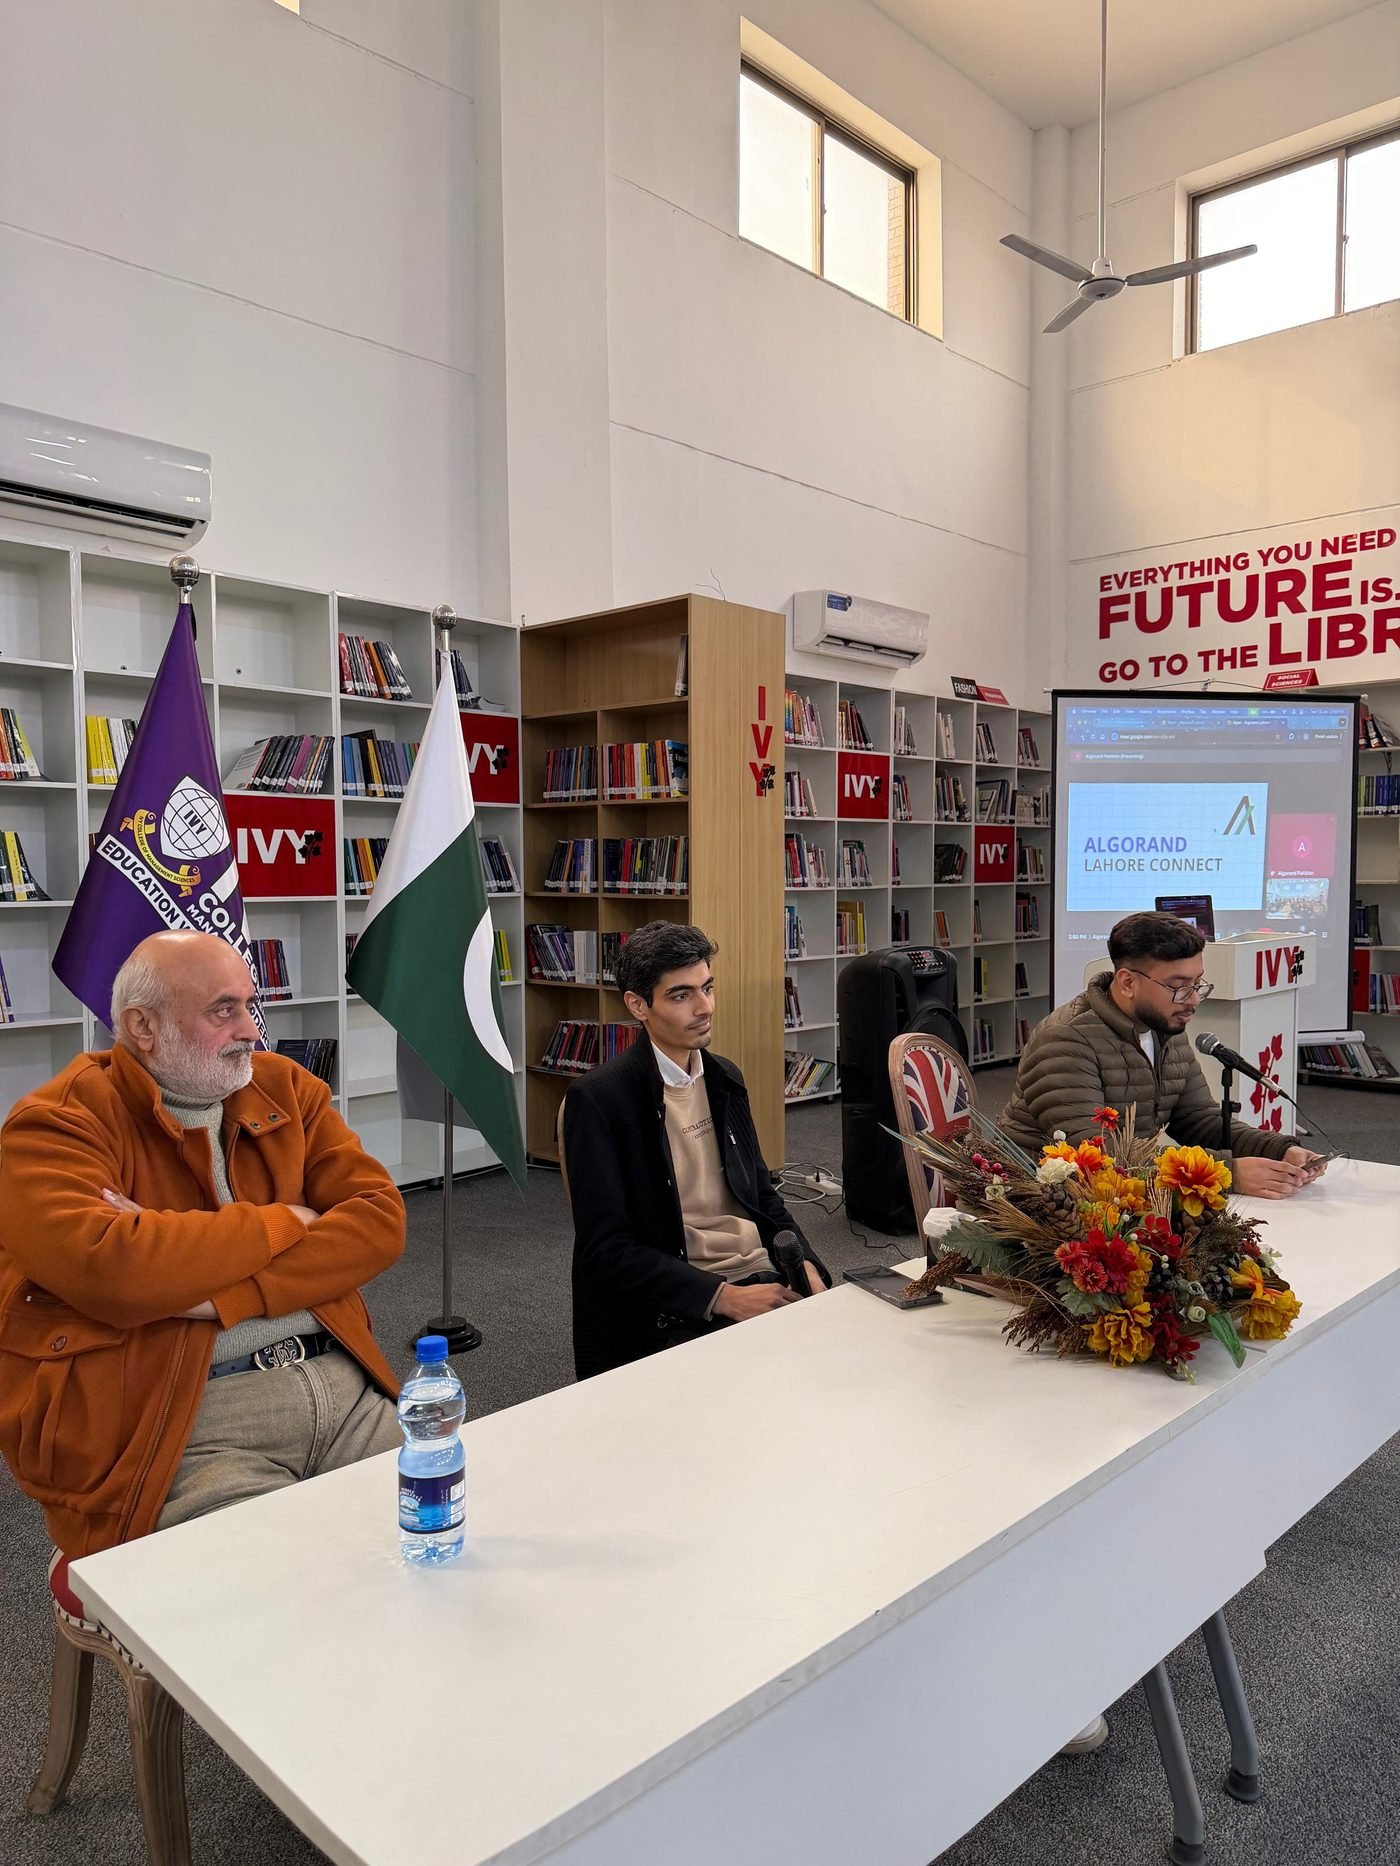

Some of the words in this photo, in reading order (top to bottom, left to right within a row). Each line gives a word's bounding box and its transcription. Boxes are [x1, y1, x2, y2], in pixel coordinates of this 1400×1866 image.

[1099, 552, 1250, 593] EVERYTHING
[1256, 541, 1313, 568] YOU
[1320, 528, 1397, 558] NEED
[1099, 559, 1353, 640] FUTURE
[1098, 659, 1140, 683] GO
[1148, 653, 1188, 678] TO
[1198, 645, 1259, 673] THE
[1268, 606, 1400, 666] LIBR
[954, 682, 978, 696] FASHION
[1277, 673, 1301, 681] SOCIAL
[749, 685, 773, 797] IVY
[467, 743, 504, 775] VY
[844, 773, 880, 799] IVY
[183, 809, 207, 835] IVY
[137, 823, 145, 846] COLLEGE
[145, 853, 174, 879] MANAGEMENT
[237, 828, 316, 866] IVY
[979, 843, 1008, 864] IVY
[1084, 836, 1188, 853] ALGORAND
[1297, 841, 1306, 852] A
[1084, 859, 1145, 872] LAHORE
[1150, 857, 1223, 872] CONNECT
[101, 839, 180, 925] EDUCATION
[1255, 945, 1301, 991] IVY
